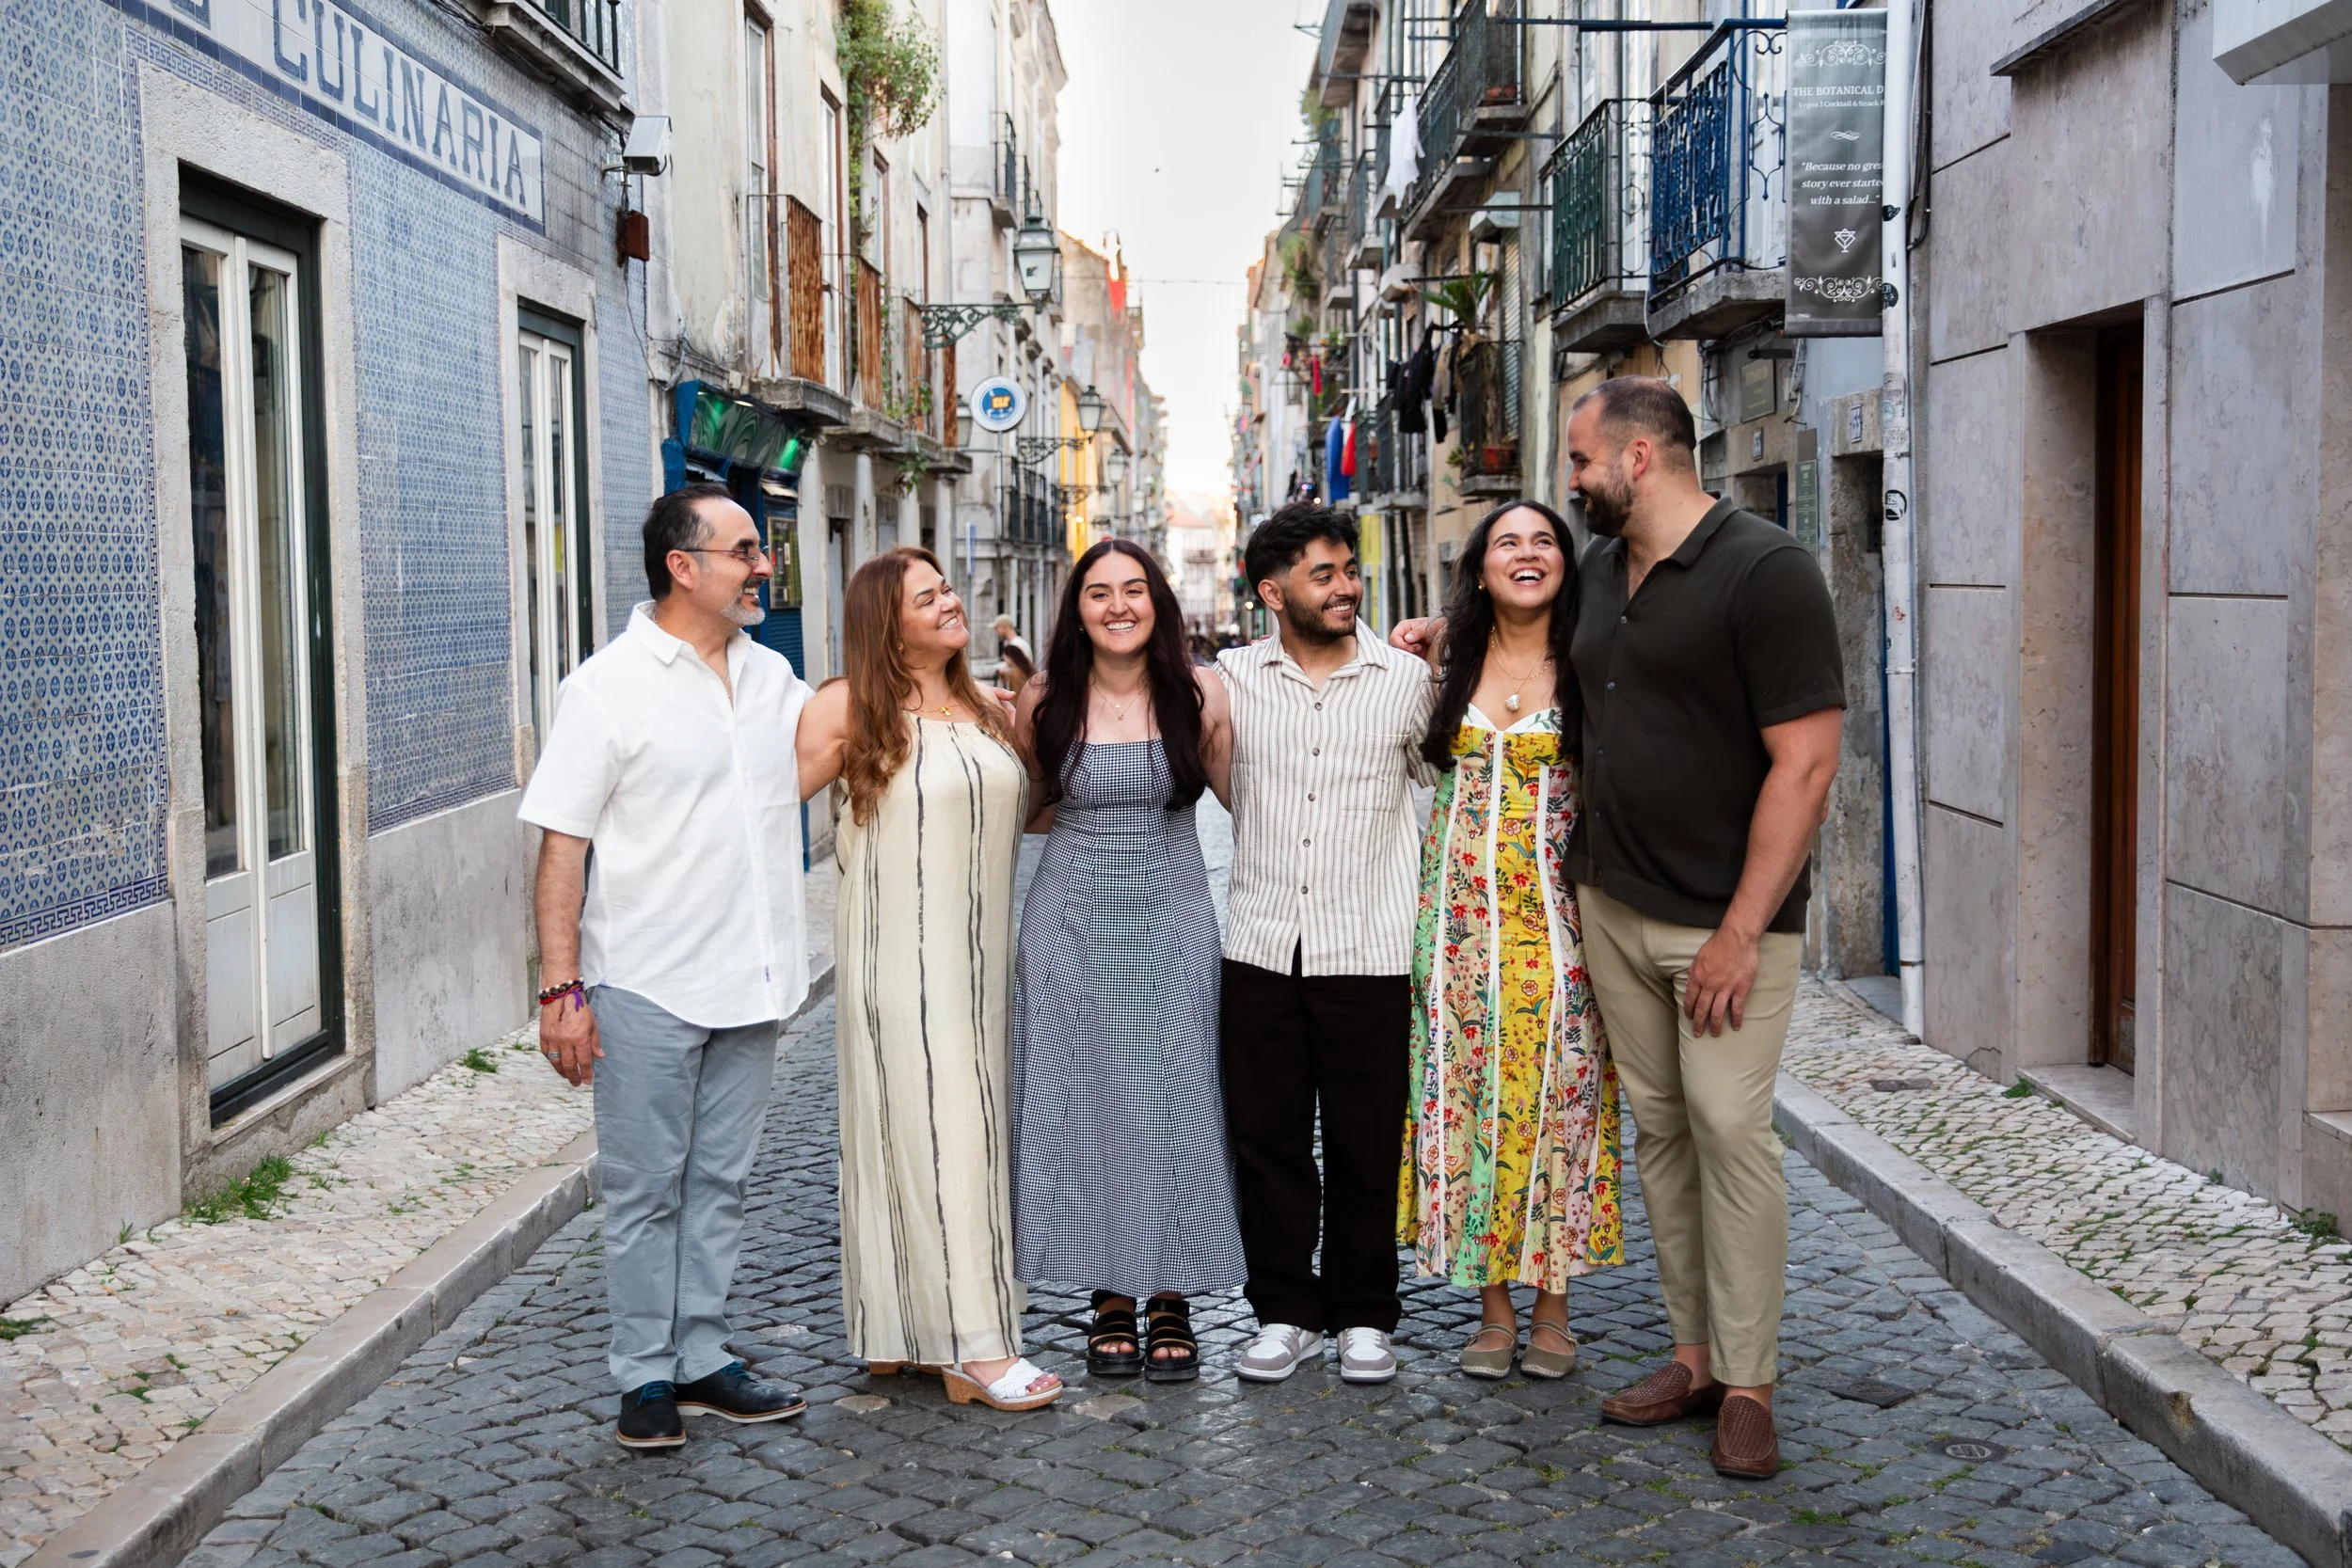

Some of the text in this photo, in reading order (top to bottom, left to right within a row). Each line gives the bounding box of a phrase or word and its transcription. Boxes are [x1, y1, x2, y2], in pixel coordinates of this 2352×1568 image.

[1792, 85, 1884, 97] THE BOTANICAL D
[1798, 100, 1820, 109] Vegan
[1823, 99, 1851, 107] Cocktail
[1859, 99, 1880, 107] Snack
[1802, 180, 1827, 189] story
[1851, 179, 1883, 187] starte
[1810, 195, 1833, 205] with
